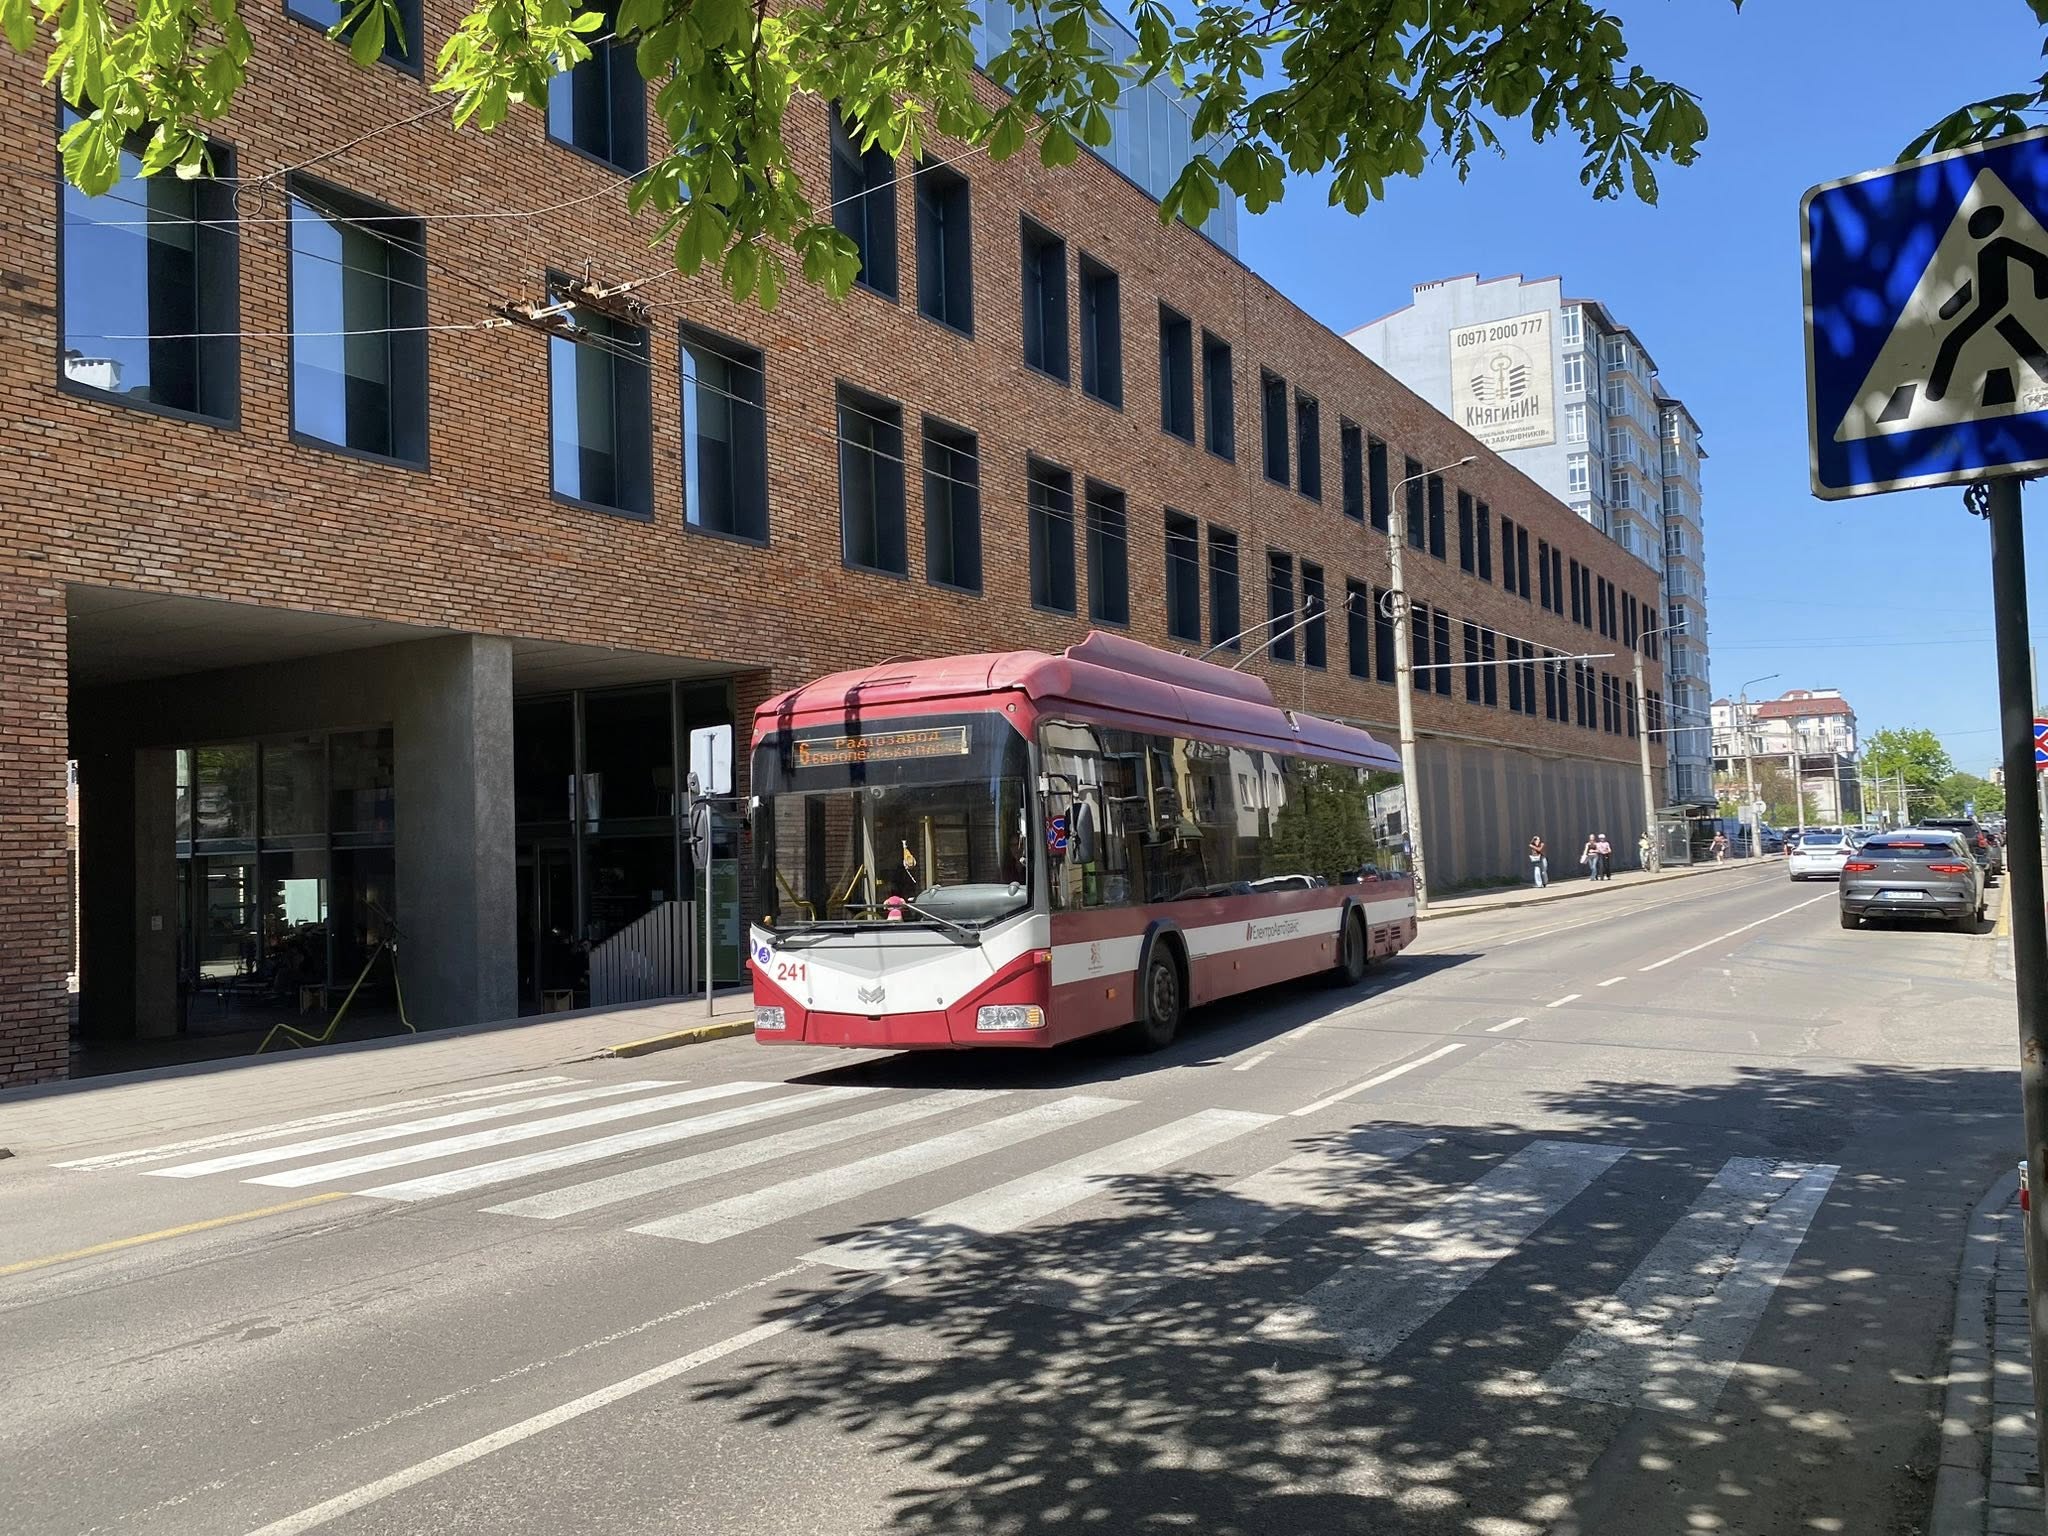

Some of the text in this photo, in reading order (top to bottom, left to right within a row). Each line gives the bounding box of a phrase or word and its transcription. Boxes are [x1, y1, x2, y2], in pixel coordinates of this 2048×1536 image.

[1457, 318, 1542, 347] (097) 2000 777
[1466, 395, 1539, 427] КНЯГИНИН
[1491, 429, 1546, 445] ЗАБУДІВНИКІВ
[799, 743, 810, 765] 6
[777, 963, 807, 982] 241
